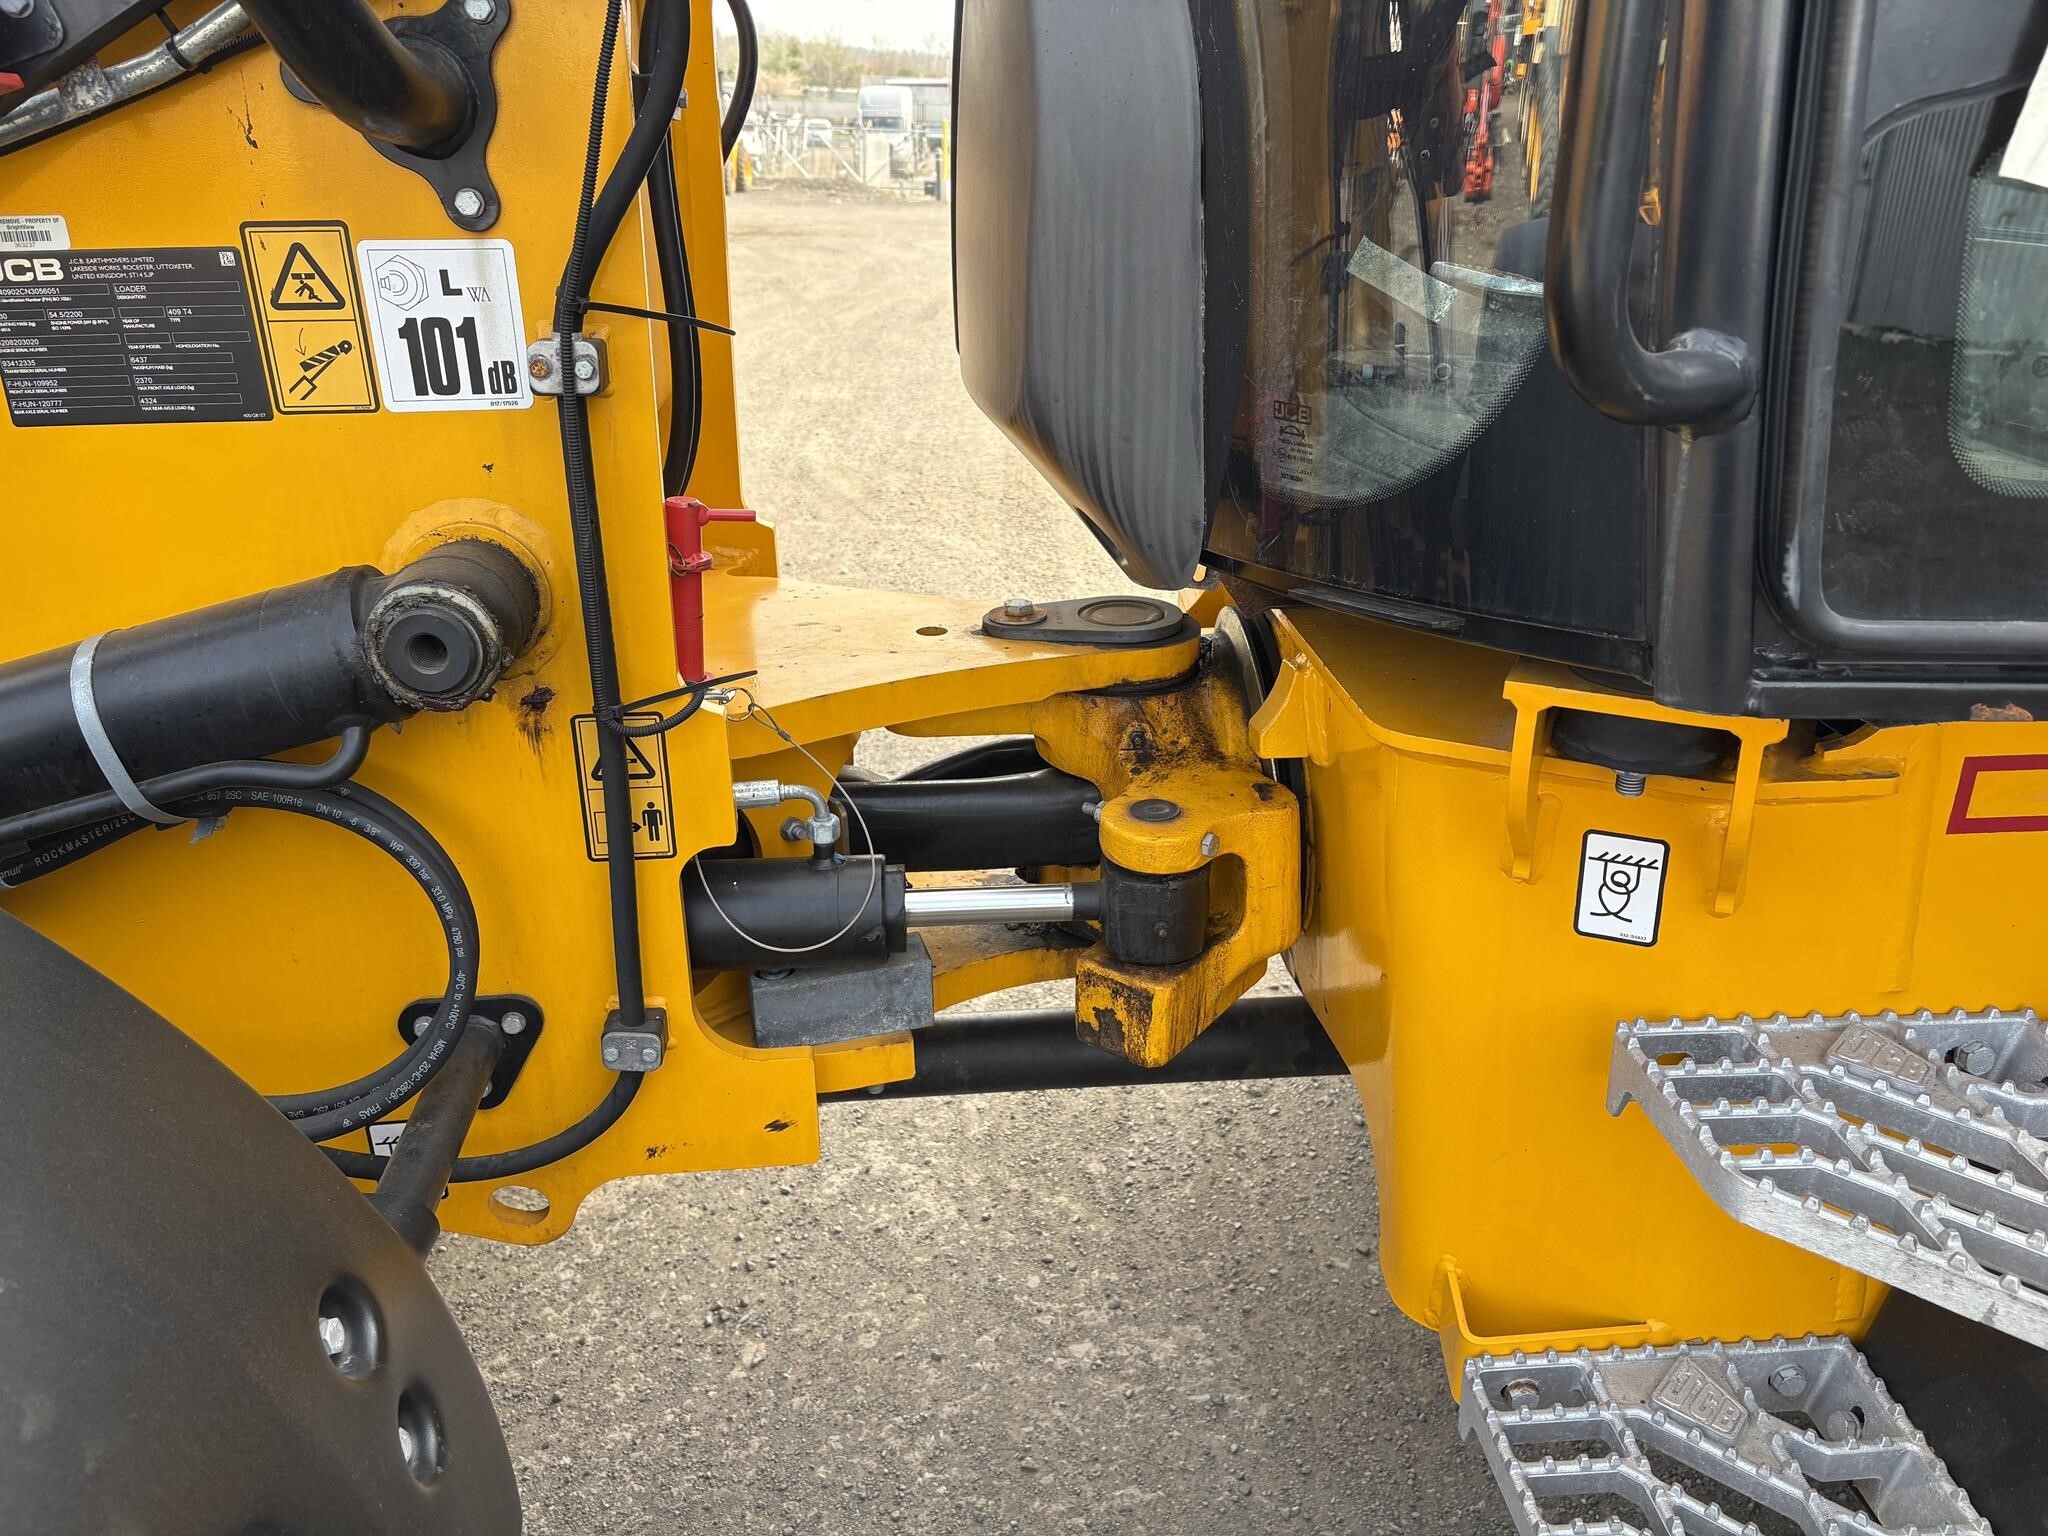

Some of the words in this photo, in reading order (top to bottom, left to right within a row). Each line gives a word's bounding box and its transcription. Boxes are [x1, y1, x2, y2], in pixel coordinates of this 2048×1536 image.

[114, 285, 147, 293] LOADER
[439, 269, 463, 296] L
[466, 287, 491, 302] WA
[398, 317, 486, 396] 101
[487, 361, 518, 395] dB
[7, 380, 58, 388] F-HUN-109952
[12, 400, 62, 408] F-HUN-120777
[206, 791, 221, 800] 857
[225, 791, 242, 801] 2SC
[251, 791, 269, 801] SAE
[273, 793, 303, 808] 100R16
[316, 802, 330, 815] DN
[331, 809, 342, 820] 10
[389, 839, 404, 852] WP
[406, 855, 421, 869] 330
[418, 868, 431, 882] bar
[441, 902, 454, 920] MPa
[451, 927, 463, 945] 4780
[456, 947, 465, 958] psi
[454, 993, 464, 1001] to
[427, 1038, 447, 1060] MSHA
[1834, 1029, 1931, 1085] JCB
[288, 1110, 305, 1118] SAE
[358, 1103, 382, 1120] FRAS
[1660, 1366, 1741, 1433] JCB
